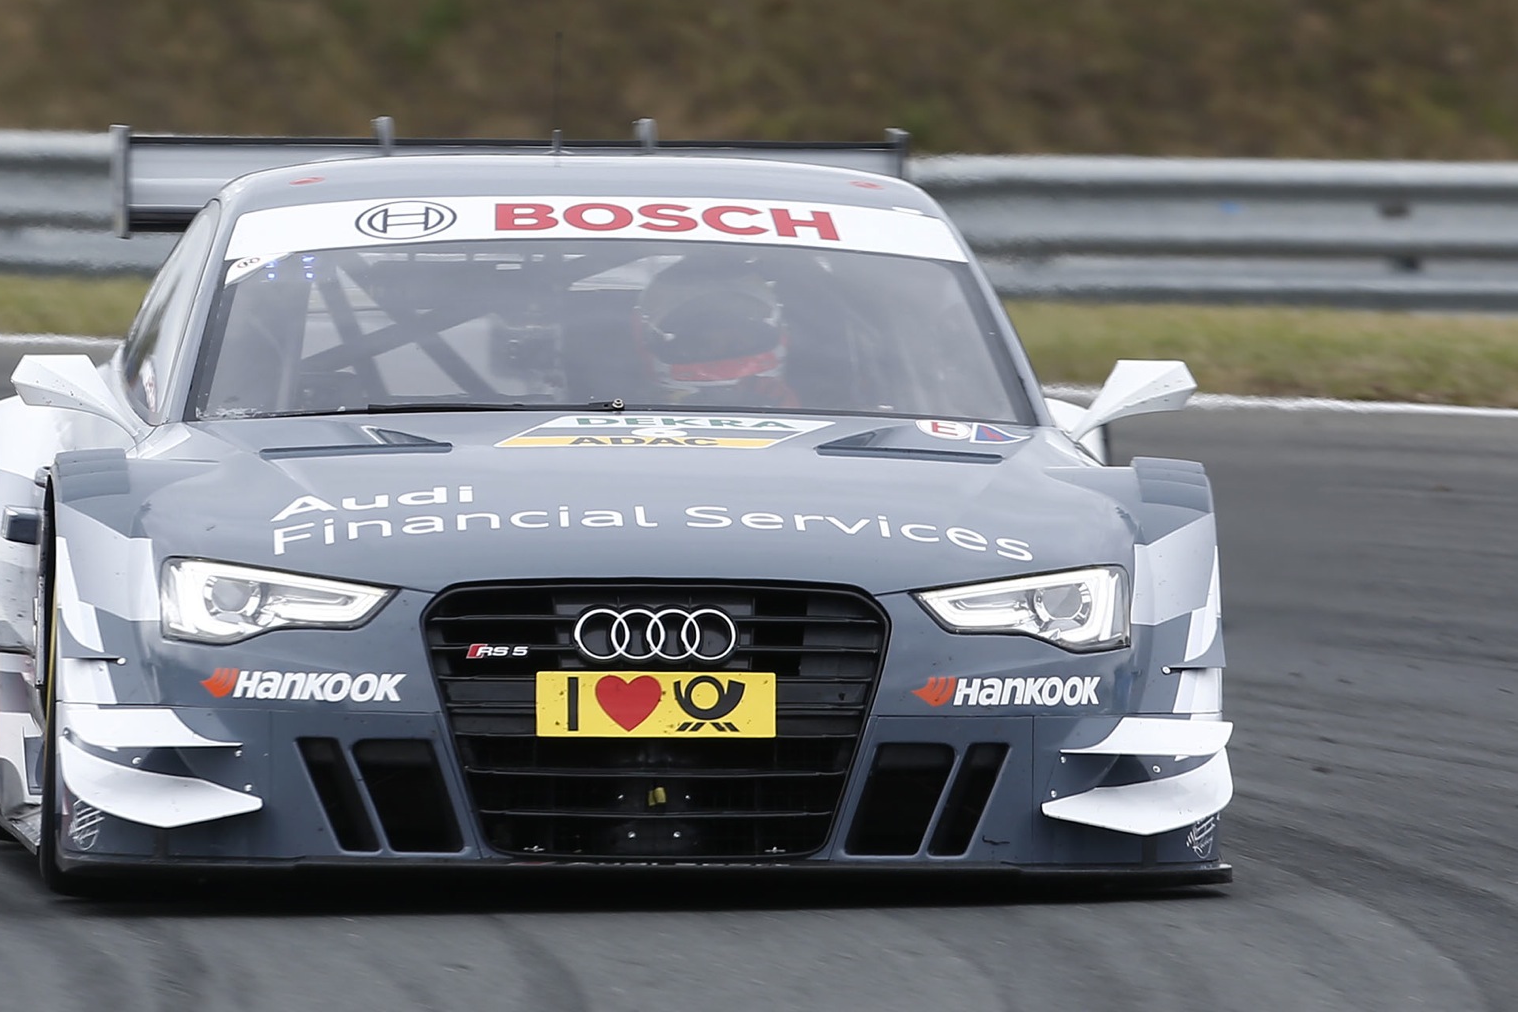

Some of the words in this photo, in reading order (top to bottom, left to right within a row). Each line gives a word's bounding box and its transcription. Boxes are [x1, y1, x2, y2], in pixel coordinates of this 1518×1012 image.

[493, 202, 841, 242] BOSCH
[568, 436, 720, 447] ADAC
[575, 417, 798, 429] DEKRA
[269, 485, 474, 523] Audi
[272, 504, 659, 556] Financial
[685, 504, 1035, 562] Services
